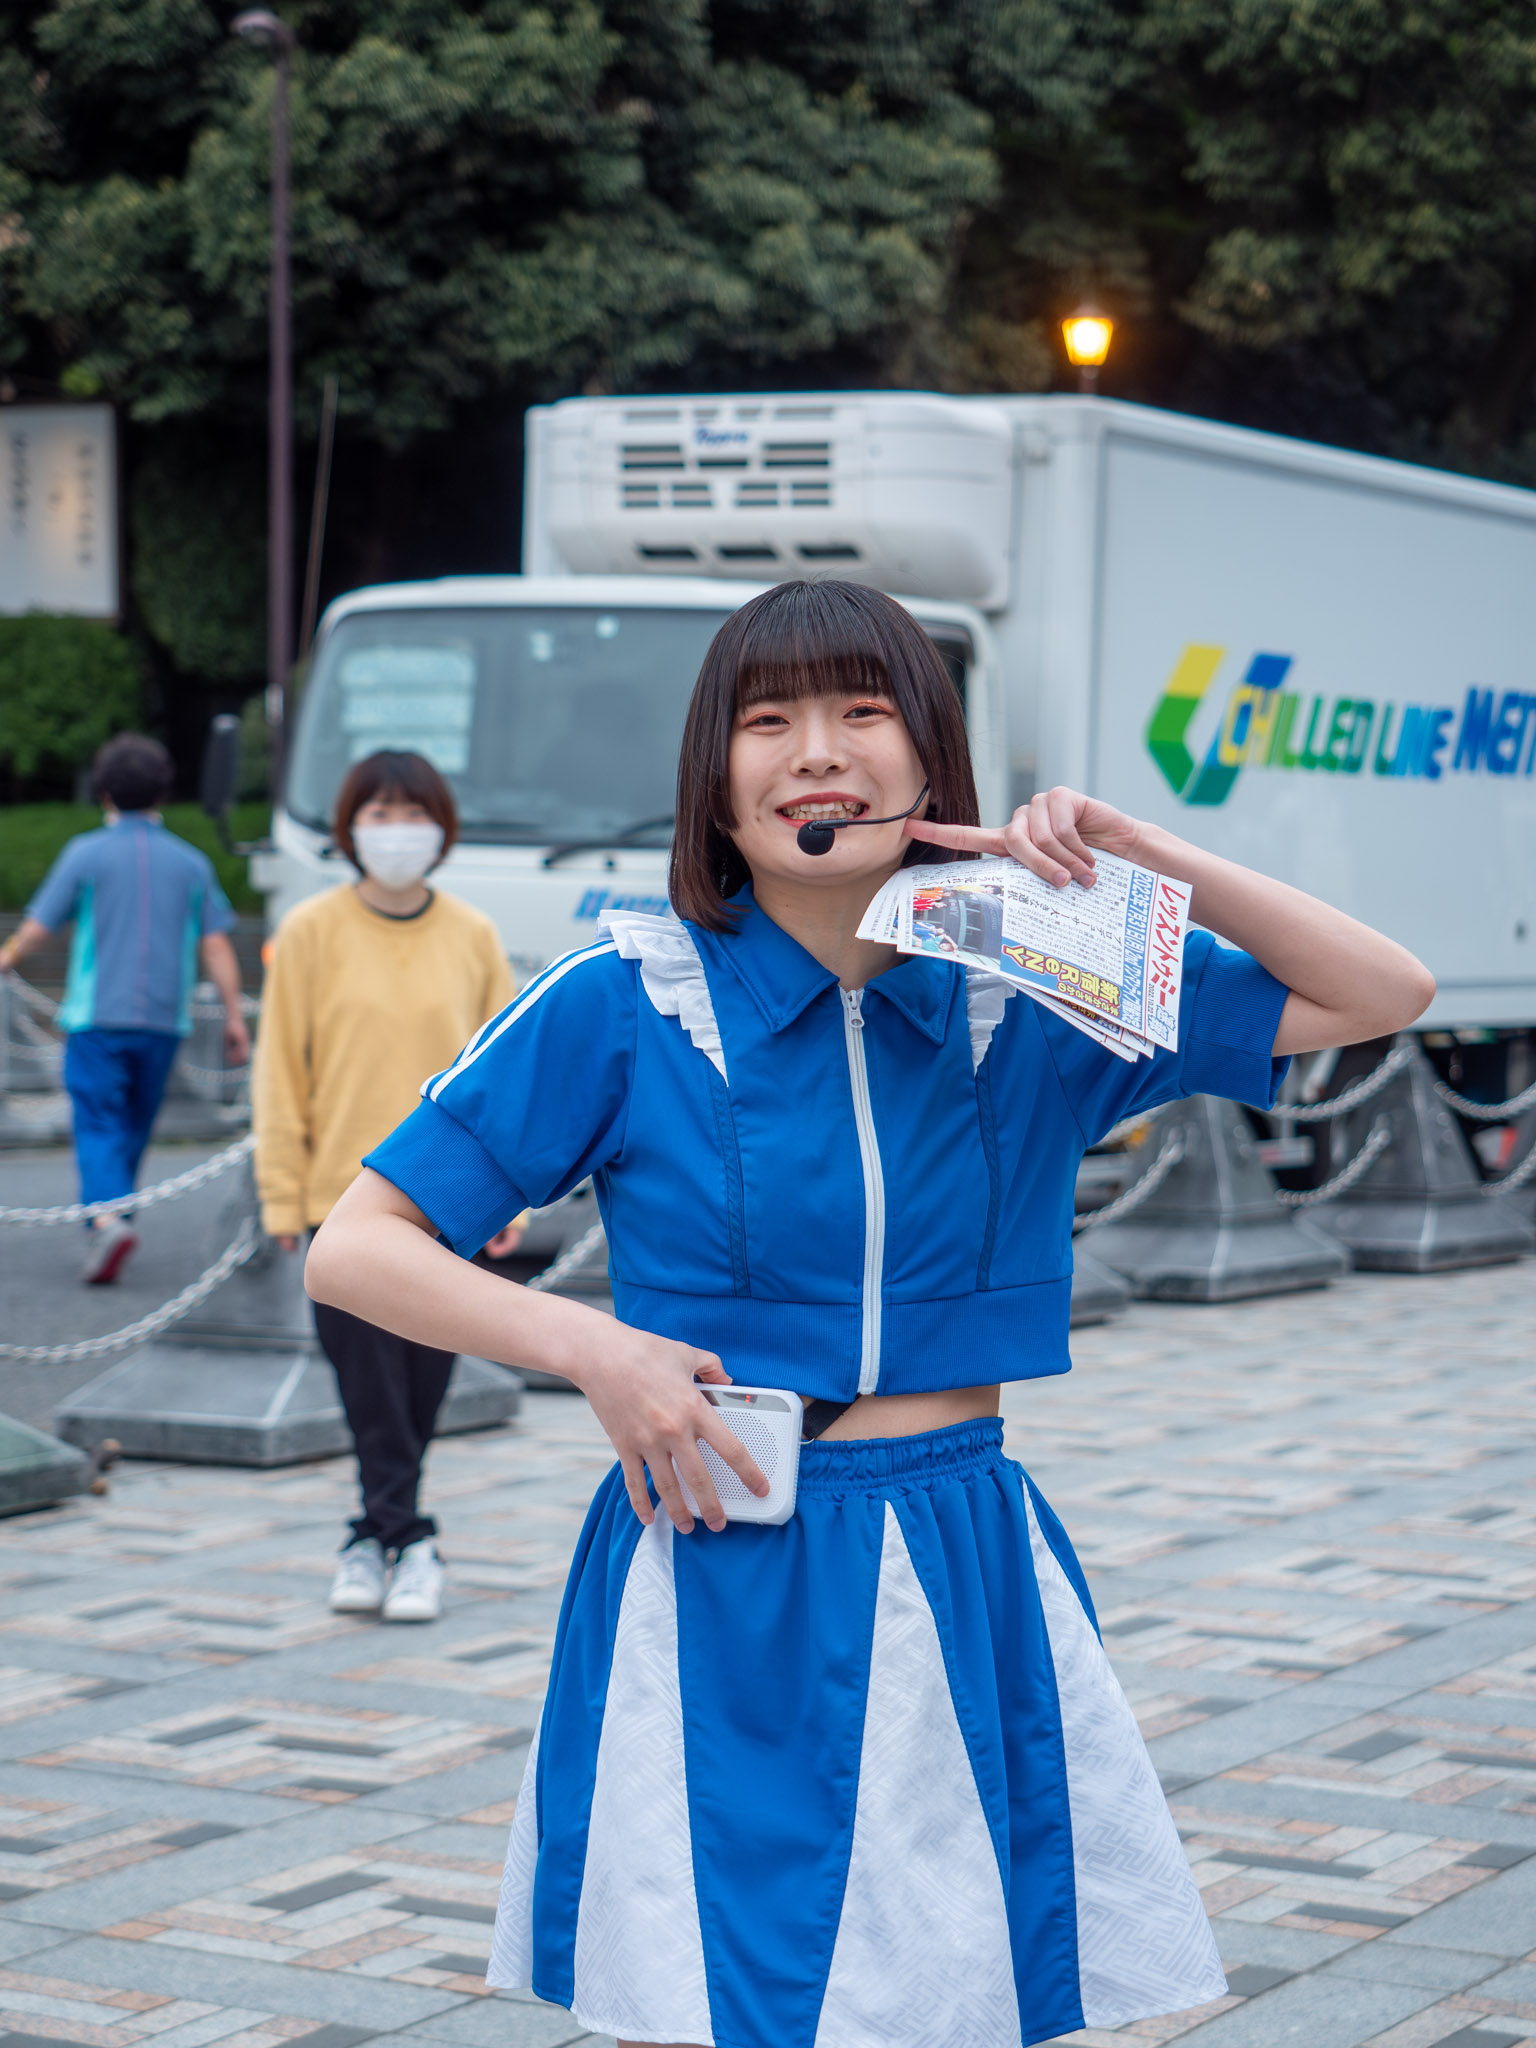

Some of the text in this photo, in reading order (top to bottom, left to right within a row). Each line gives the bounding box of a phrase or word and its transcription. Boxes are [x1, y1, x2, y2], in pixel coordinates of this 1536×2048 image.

[1219, 684, 1374, 772] CHILLED
[1373, 703, 1453, 780] LINE
[1003, 944, 1121, 1007] 新宿ReNY
[1058, 982, 1121, 1018] まさかまさかの
